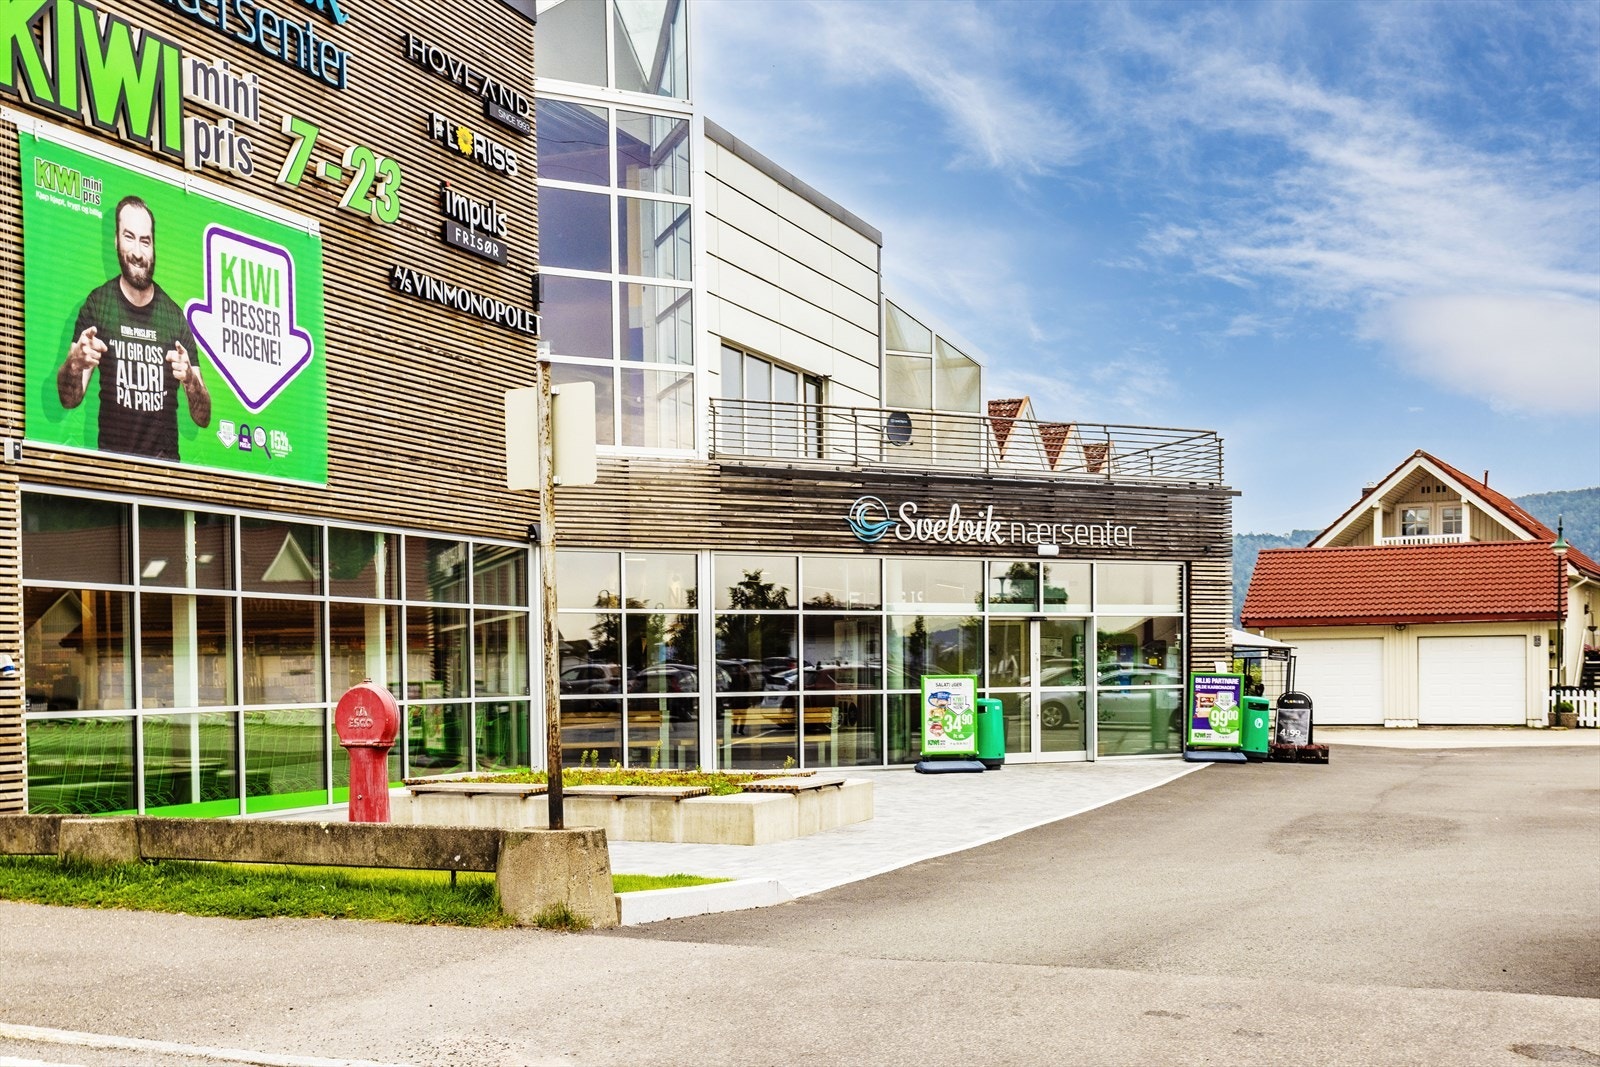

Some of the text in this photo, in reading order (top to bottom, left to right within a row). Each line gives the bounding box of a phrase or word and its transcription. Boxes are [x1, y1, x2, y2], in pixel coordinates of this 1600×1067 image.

[0, 0, 187, 157] KIWI
[190, 58, 260, 122] mini
[406, 33, 530, 117] HOVLAND
[498, 109, 516, 126] SINCE
[191, 117, 254, 177] pris
[34, 156, 81, 200] KIWI
[82, 175, 103, 194] mini
[83, 190, 102, 207] pris
[443, 180, 509, 237] impuls
[454, 227, 500, 258] FRISØR
[221, 252, 280, 308] KIWI
[222, 297, 280, 338] PRESSER
[410, 270, 544, 336] VINMONOPOLET
[127, 341, 144, 362] GIR
[145, 345, 164, 365] OSS
[223, 328, 281, 367] PRISENE!
[116, 359, 164, 392] ALDRI
[116, 383, 132, 409] PÅ
[895, 501, 1137, 547] Svelvik nærsenter
